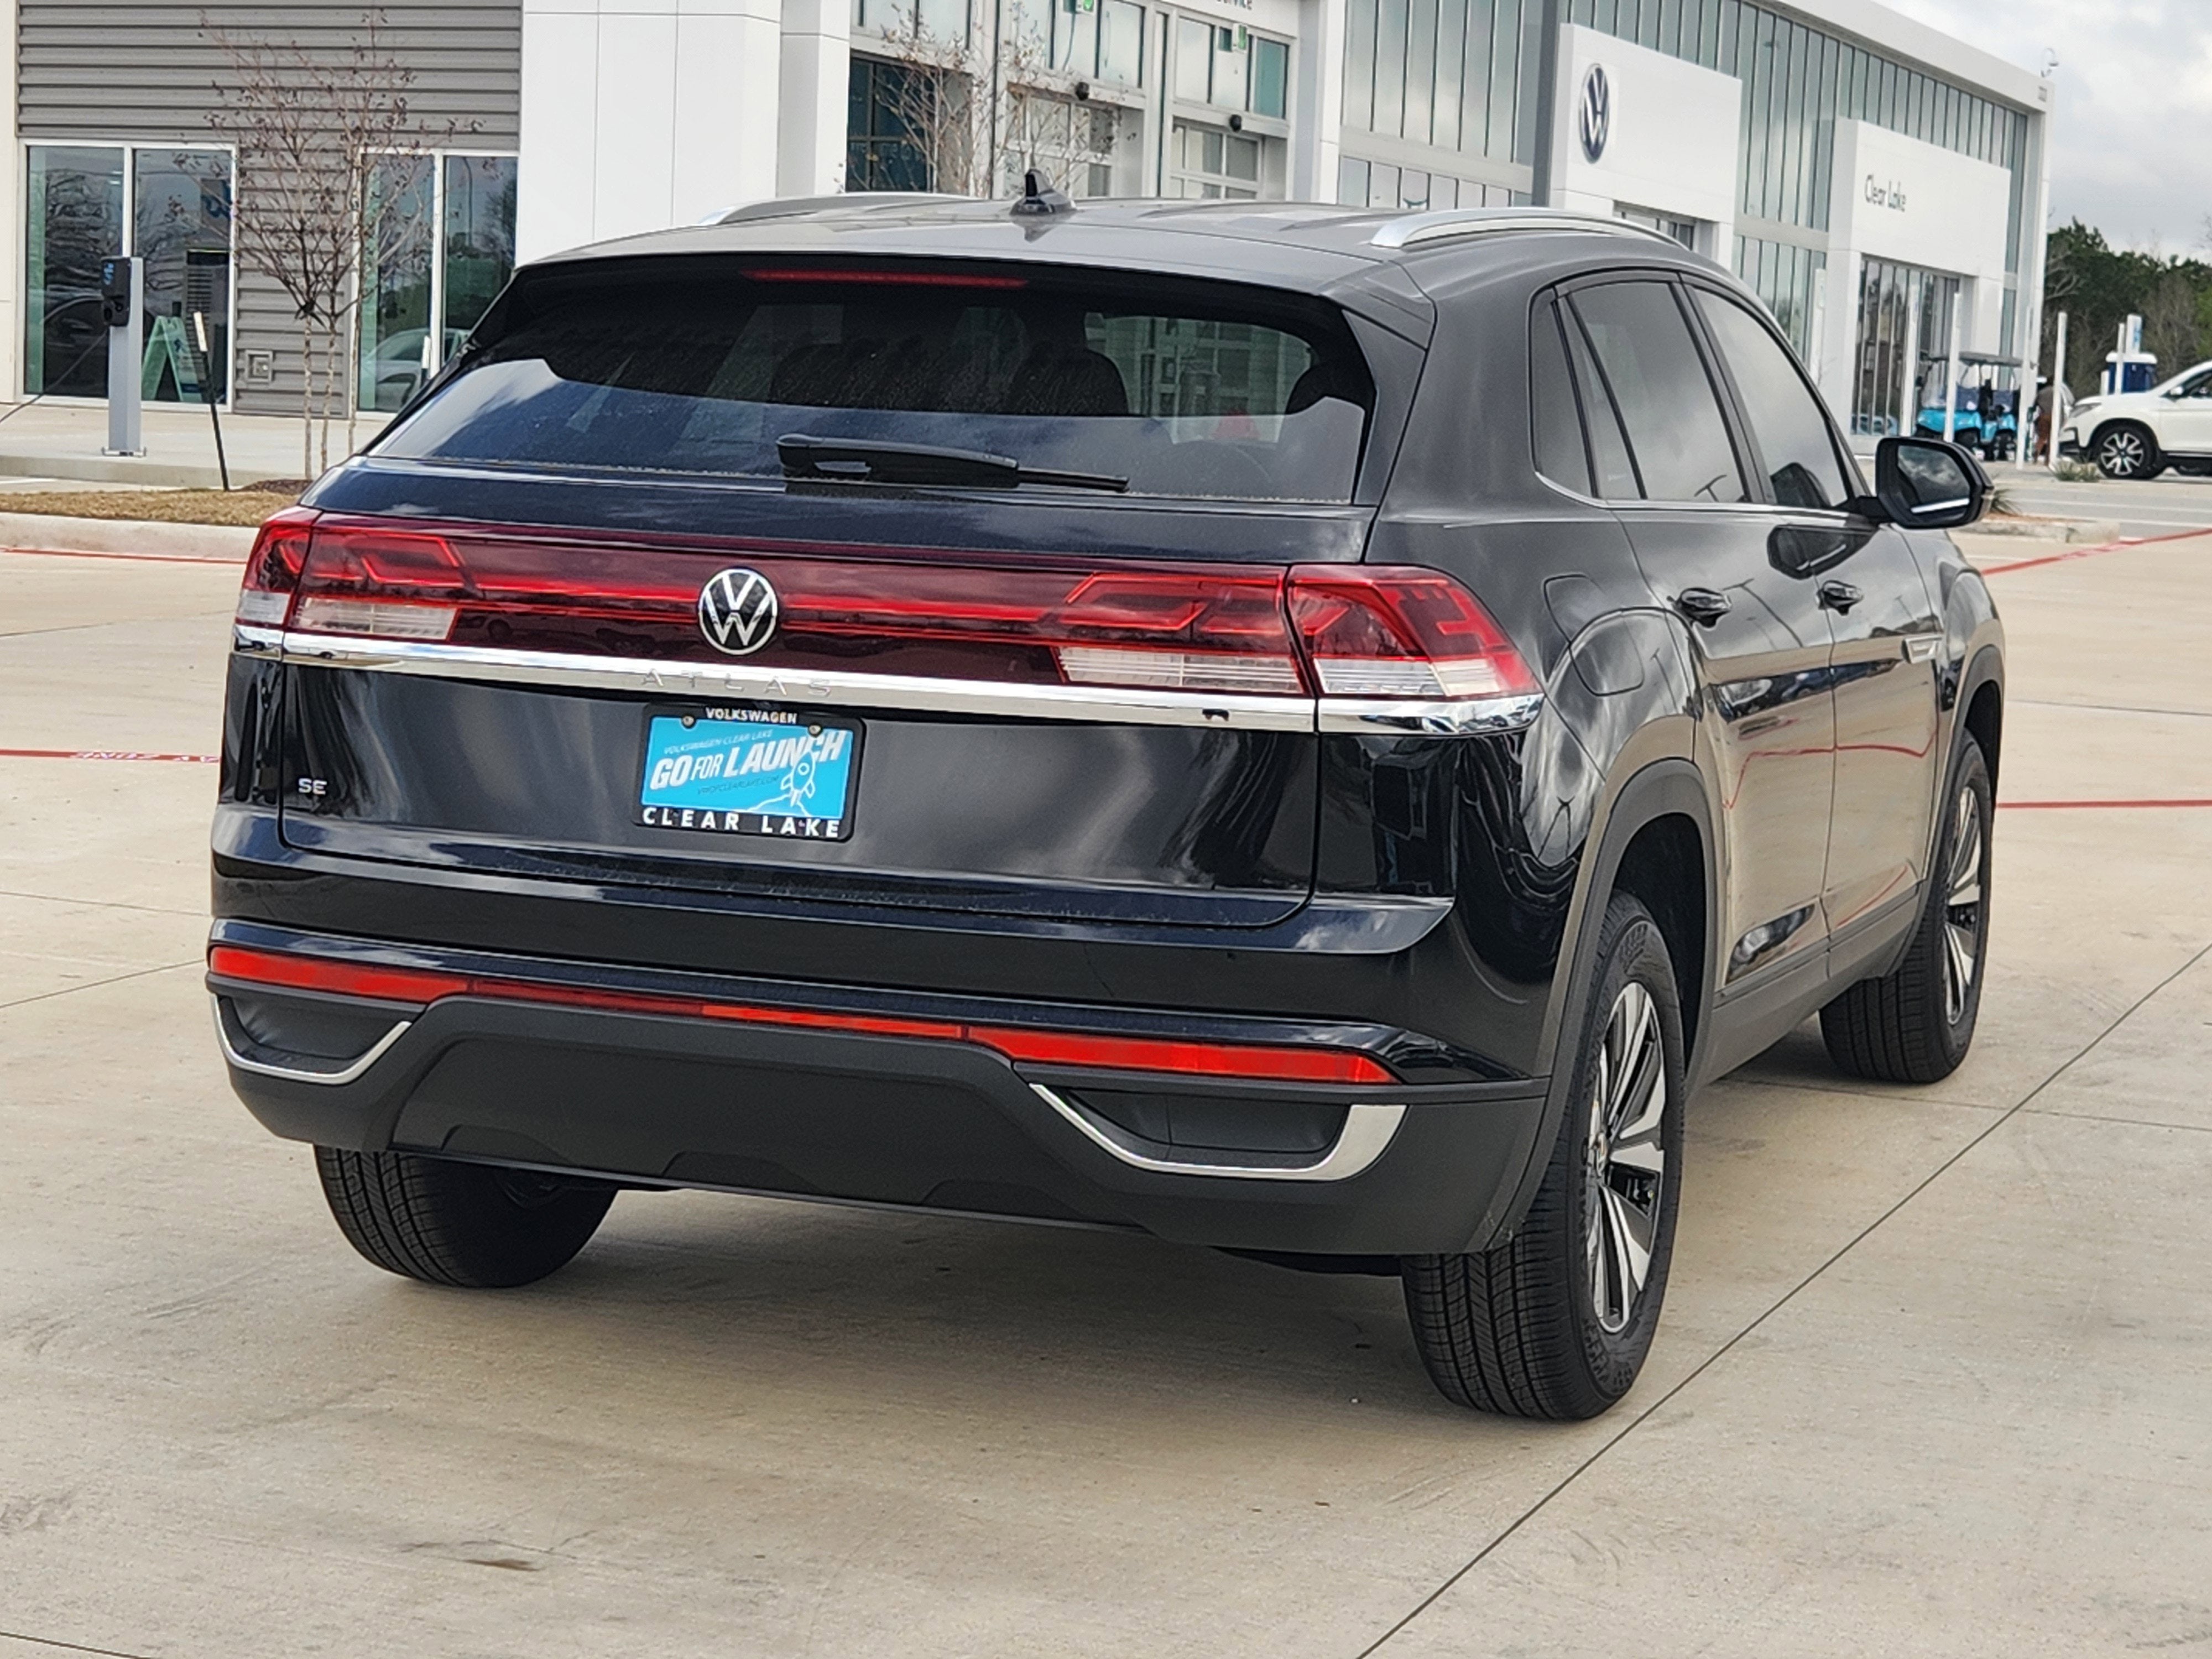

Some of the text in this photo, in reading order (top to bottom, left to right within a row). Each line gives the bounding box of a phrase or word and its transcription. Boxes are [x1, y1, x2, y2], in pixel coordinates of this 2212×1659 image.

[1865, 174, 1907, 212] Clear Lake
[700, 570, 775, 653] VW
[642, 669, 831, 697] ATLAS
[706, 707, 797, 724] VOLKSWAGEN
[722, 734, 751, 745] CLEAR
[752, 729, 774, 740] LAKE
[650, 755, 693, 790] GO
[690, 753, 724, 780] FOR
[723, 730, 847, 777] LAUNCH
[299, 778, 327, 795] SE
[643, 806, 839, 837] CLEAR LAKE
